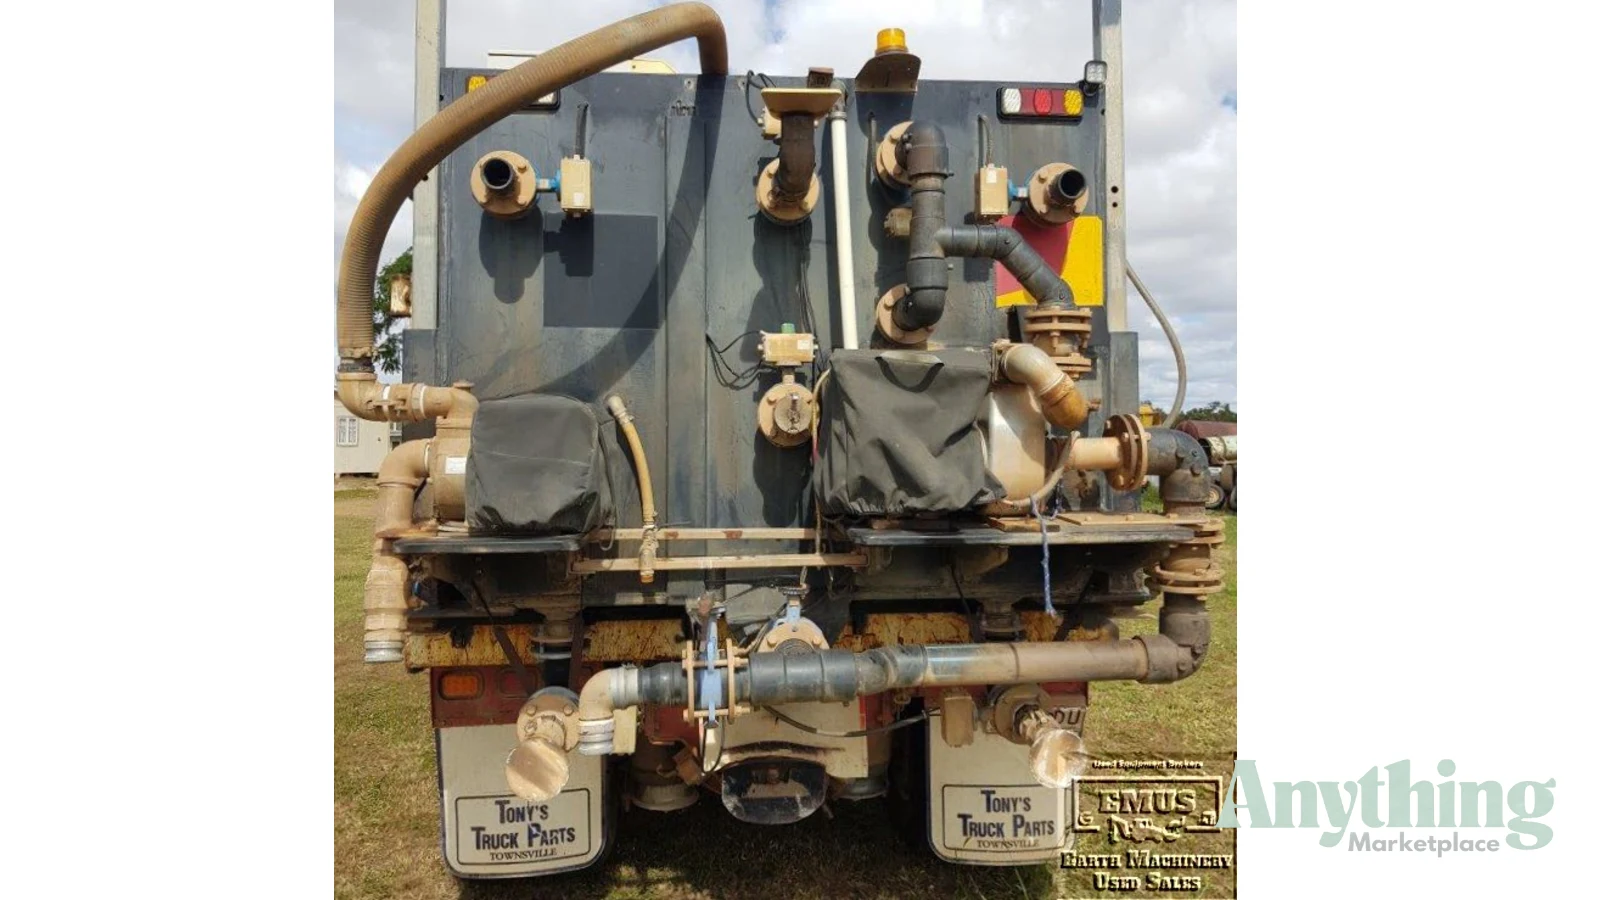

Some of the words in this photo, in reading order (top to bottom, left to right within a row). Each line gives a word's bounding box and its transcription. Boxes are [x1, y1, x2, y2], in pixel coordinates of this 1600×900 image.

[495, 800, 549, 824] TONY'S
[980, 789, 1031, 813] TONY'S
[471, 826, 519, 850] TRUCK
[527, 823, 576, 848] PARTS
[957, 813, 1005, 838] TRUCK
[1012, 814, 1055, 837] PARTS
[489, 848, 558, 861] TOWNSVILLE
[977, 839, 1040, 848] TOWNSVILLE
